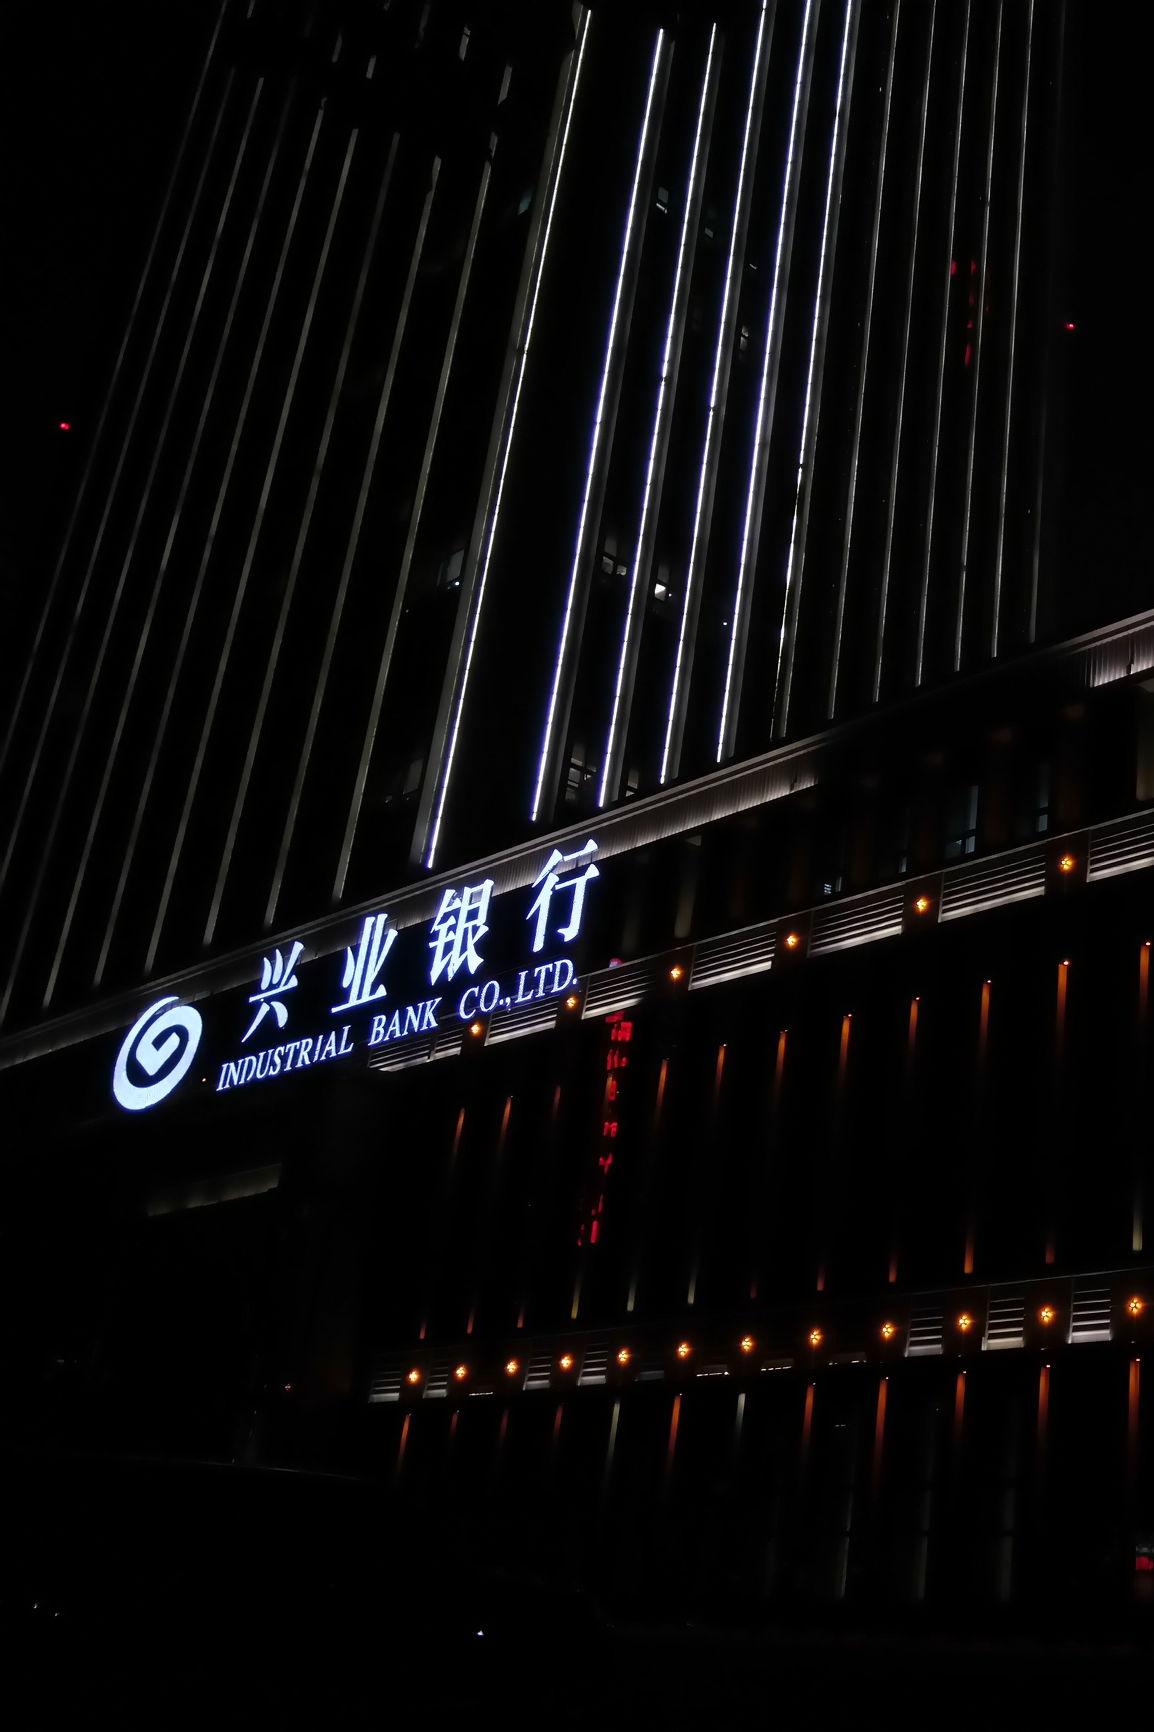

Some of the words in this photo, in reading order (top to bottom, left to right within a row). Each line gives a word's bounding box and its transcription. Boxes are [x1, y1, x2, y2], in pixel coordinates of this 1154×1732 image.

[242, 839, 600, 1043] 兴业银行
[216, 1025, 354, 1093] INDUSTRIAL
[368, 997, 443, 1047] BANK
